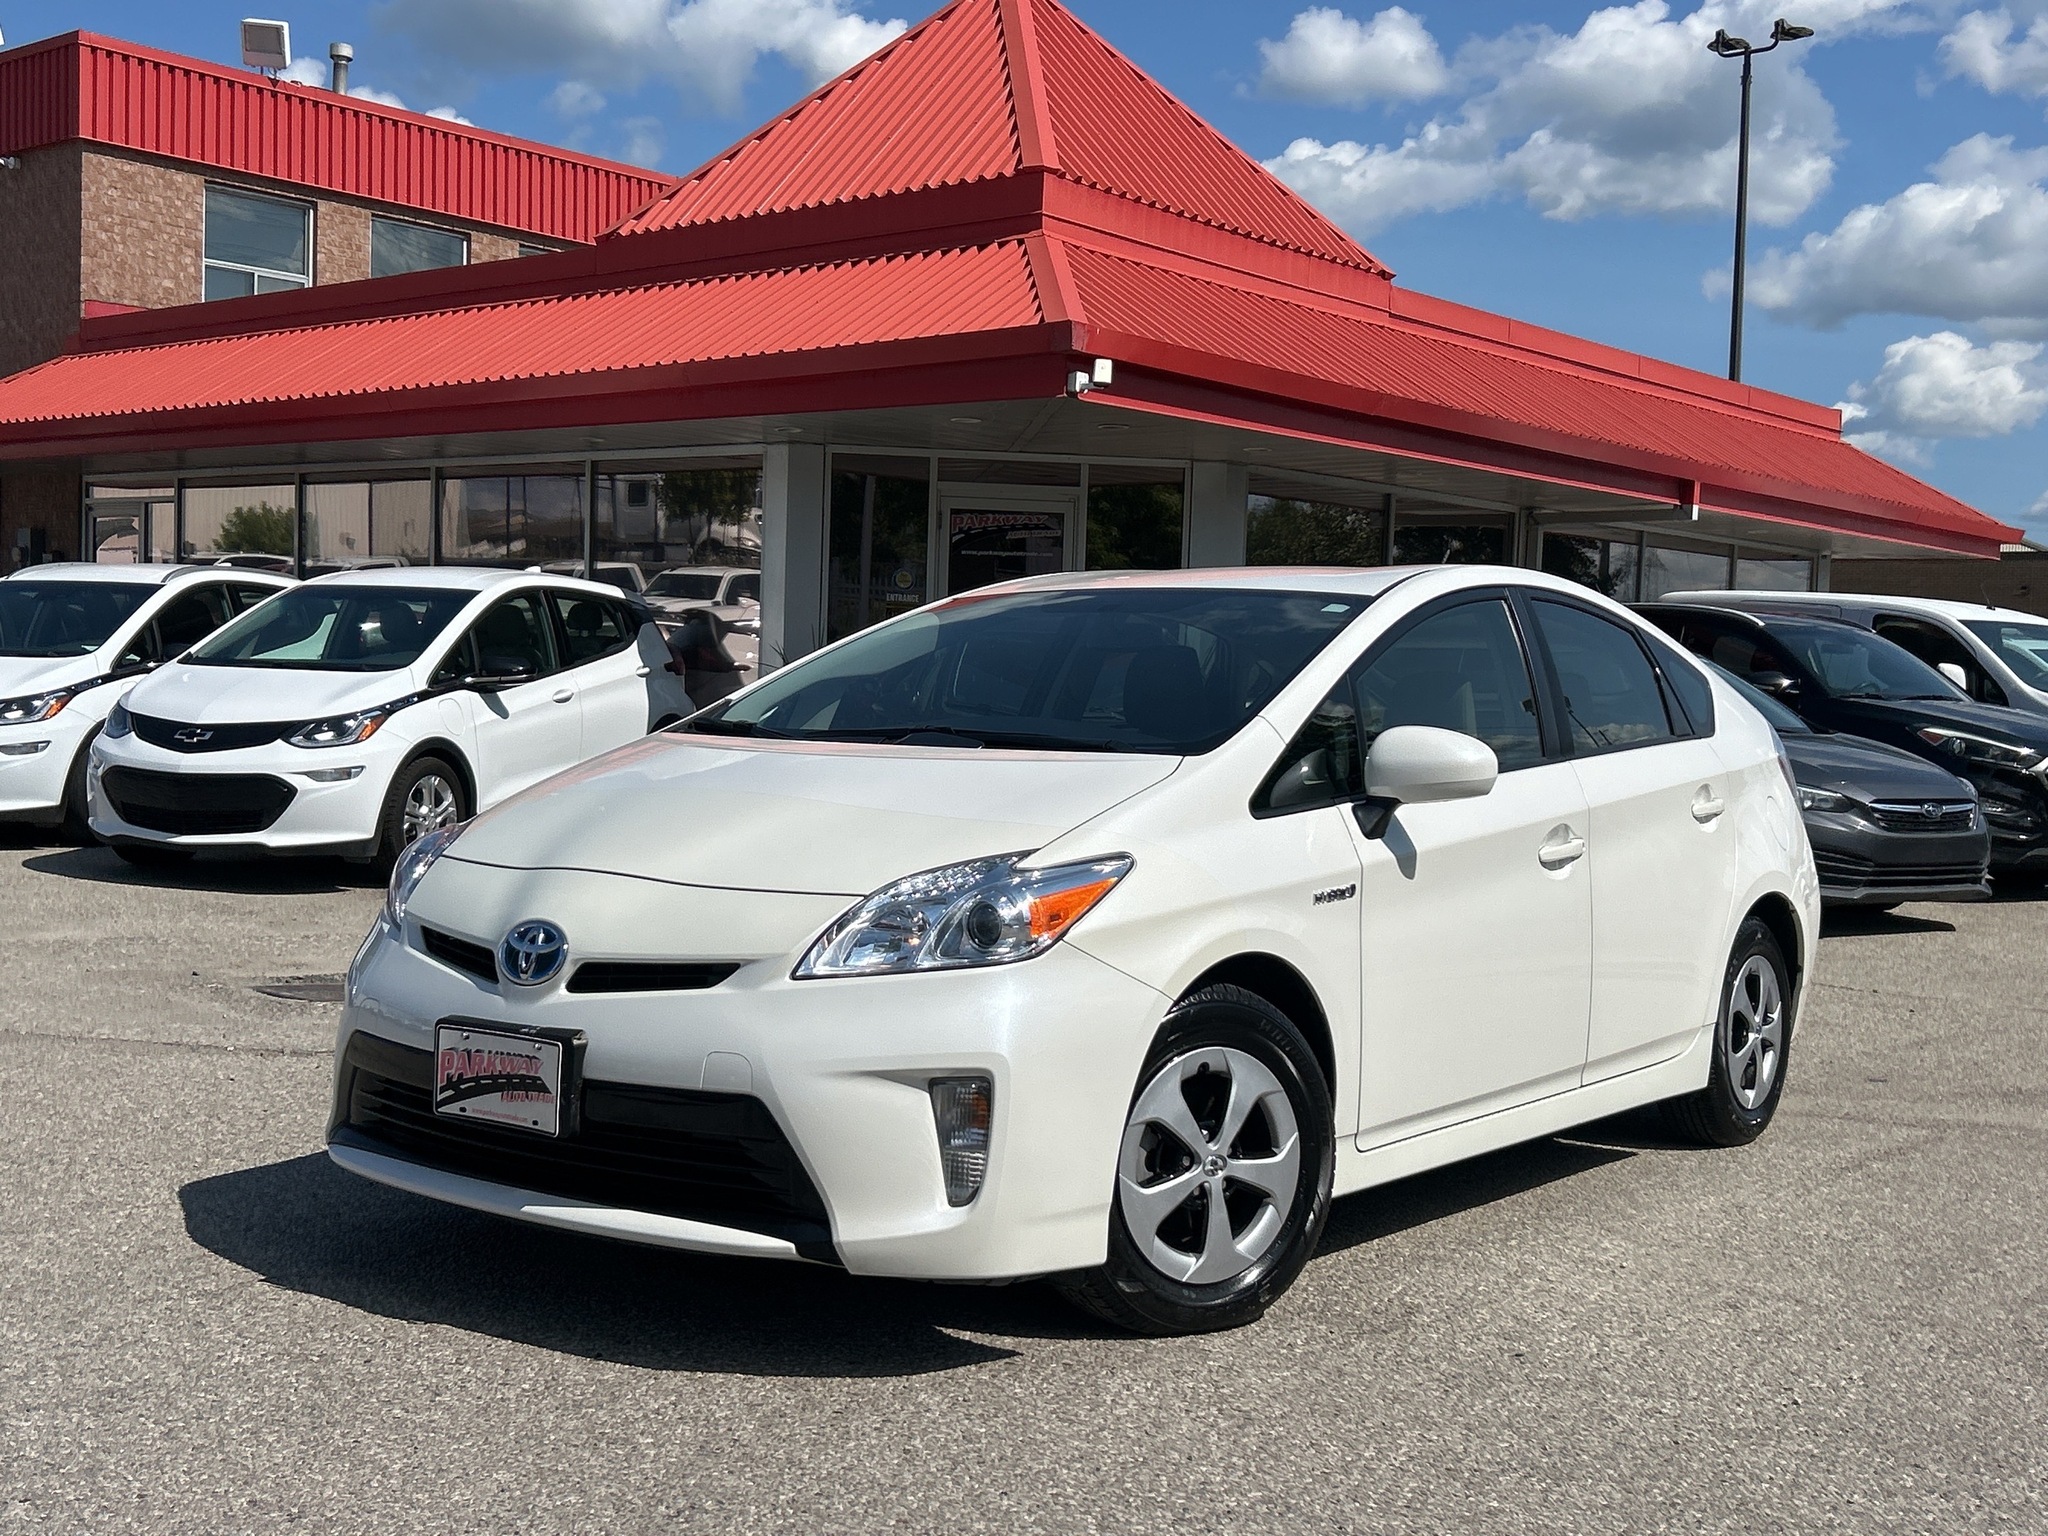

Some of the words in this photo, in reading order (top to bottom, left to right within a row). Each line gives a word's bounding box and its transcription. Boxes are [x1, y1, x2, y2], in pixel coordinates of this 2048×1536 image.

[952, 514, 1049, 534] PARKWAY
[886, 593, 919, 602] ENTRANCE
[439, 1049, 543, 1087] PARKWAY
